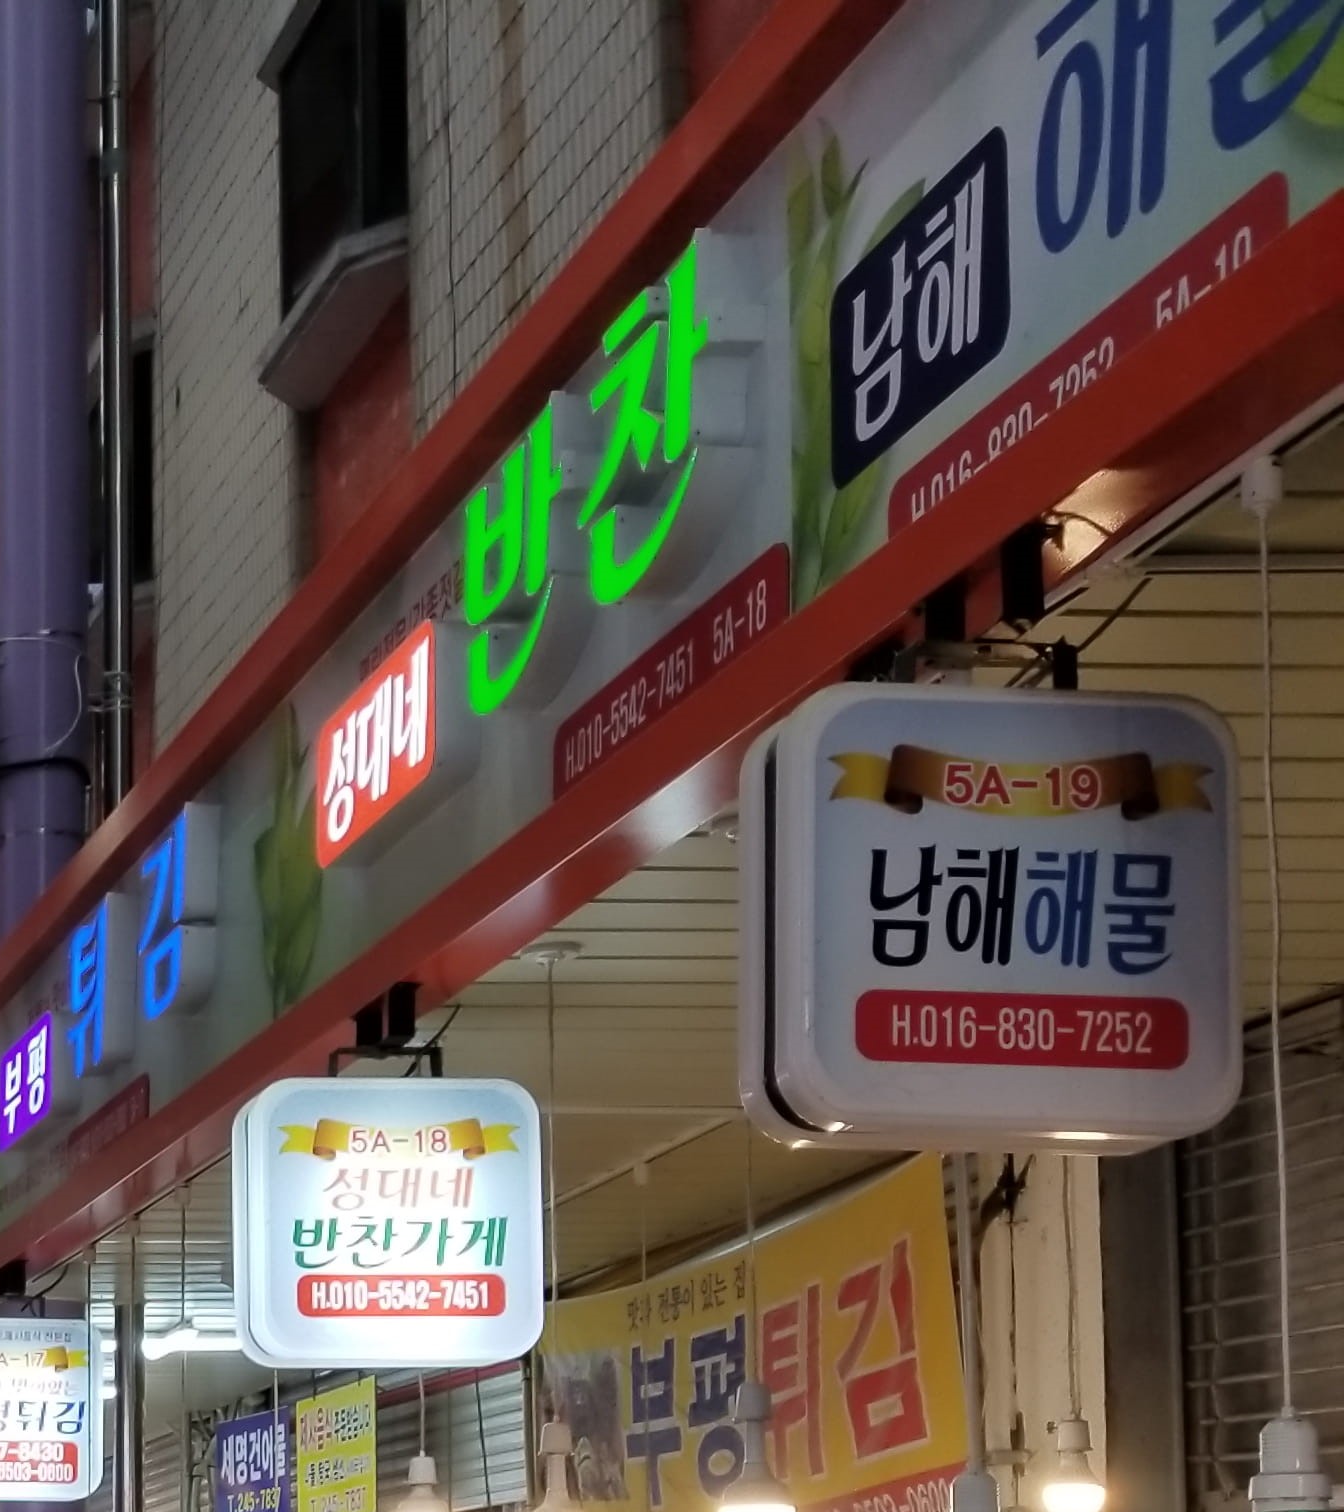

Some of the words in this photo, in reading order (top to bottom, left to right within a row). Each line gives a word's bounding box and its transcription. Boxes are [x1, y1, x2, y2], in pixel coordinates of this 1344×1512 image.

[853, 162, 986, 443] 남해
[464, 238, 709, 716] 반찬
[564, 638, 695, 783] H.010-5542-7451
[712, 577, 768, 665] 5A-18
[324, 635, 430, 844] 성대네
[945, 763, 1102, 808] 5A-19
[868, 843, 1176, 975] 남해해물
[67, 806, 187, 1078] 튀김
[892, 1003, 1154, 1054] H.016-830-7252
[3, 1025, 48, 1136] 부평
[352, 1129, 448, 1154] 5A-18
[322, 1165, 475, 1211] 성대네
[292, 1215, 508, 1269] 반찬가게
[311, 1280, 490, 1311] H.010-5542-7451
[699, 1270, 729, 1308] 있는
[221, 1422, 287, 1486] 세명건어물
